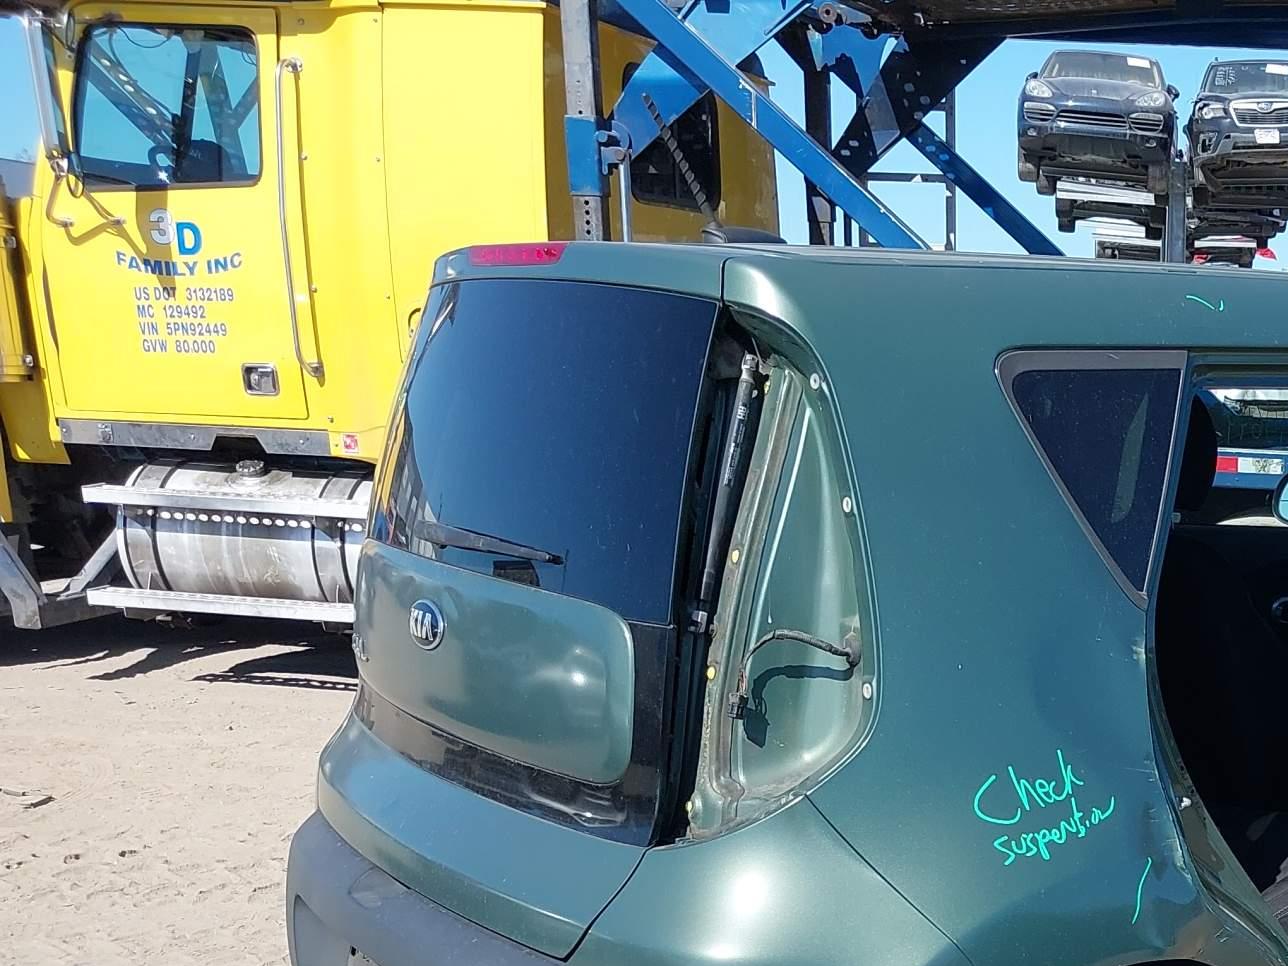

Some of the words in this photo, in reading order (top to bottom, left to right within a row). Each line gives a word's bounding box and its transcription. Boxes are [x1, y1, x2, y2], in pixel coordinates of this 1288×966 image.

[149, 208, 202, 256] 3D
[116, 251, 198, 276] FAMILY
[206, 252, 242, 275] INC
[134, 286, 150, 301] US
[154, 286, 177, 301] DOT
[186, 287, 234, 302] 3132189
[137, 304, 155, 319] MC
[163, 304, 206, 319] 129492
[139, 321, 159, 336] VIN
[166, 322, 228, 337] 5PN92449
[142, 339, 168, 353] GVW
[409, 607, 433, 641] KIA
[973, 748, 1085, 825] Check
